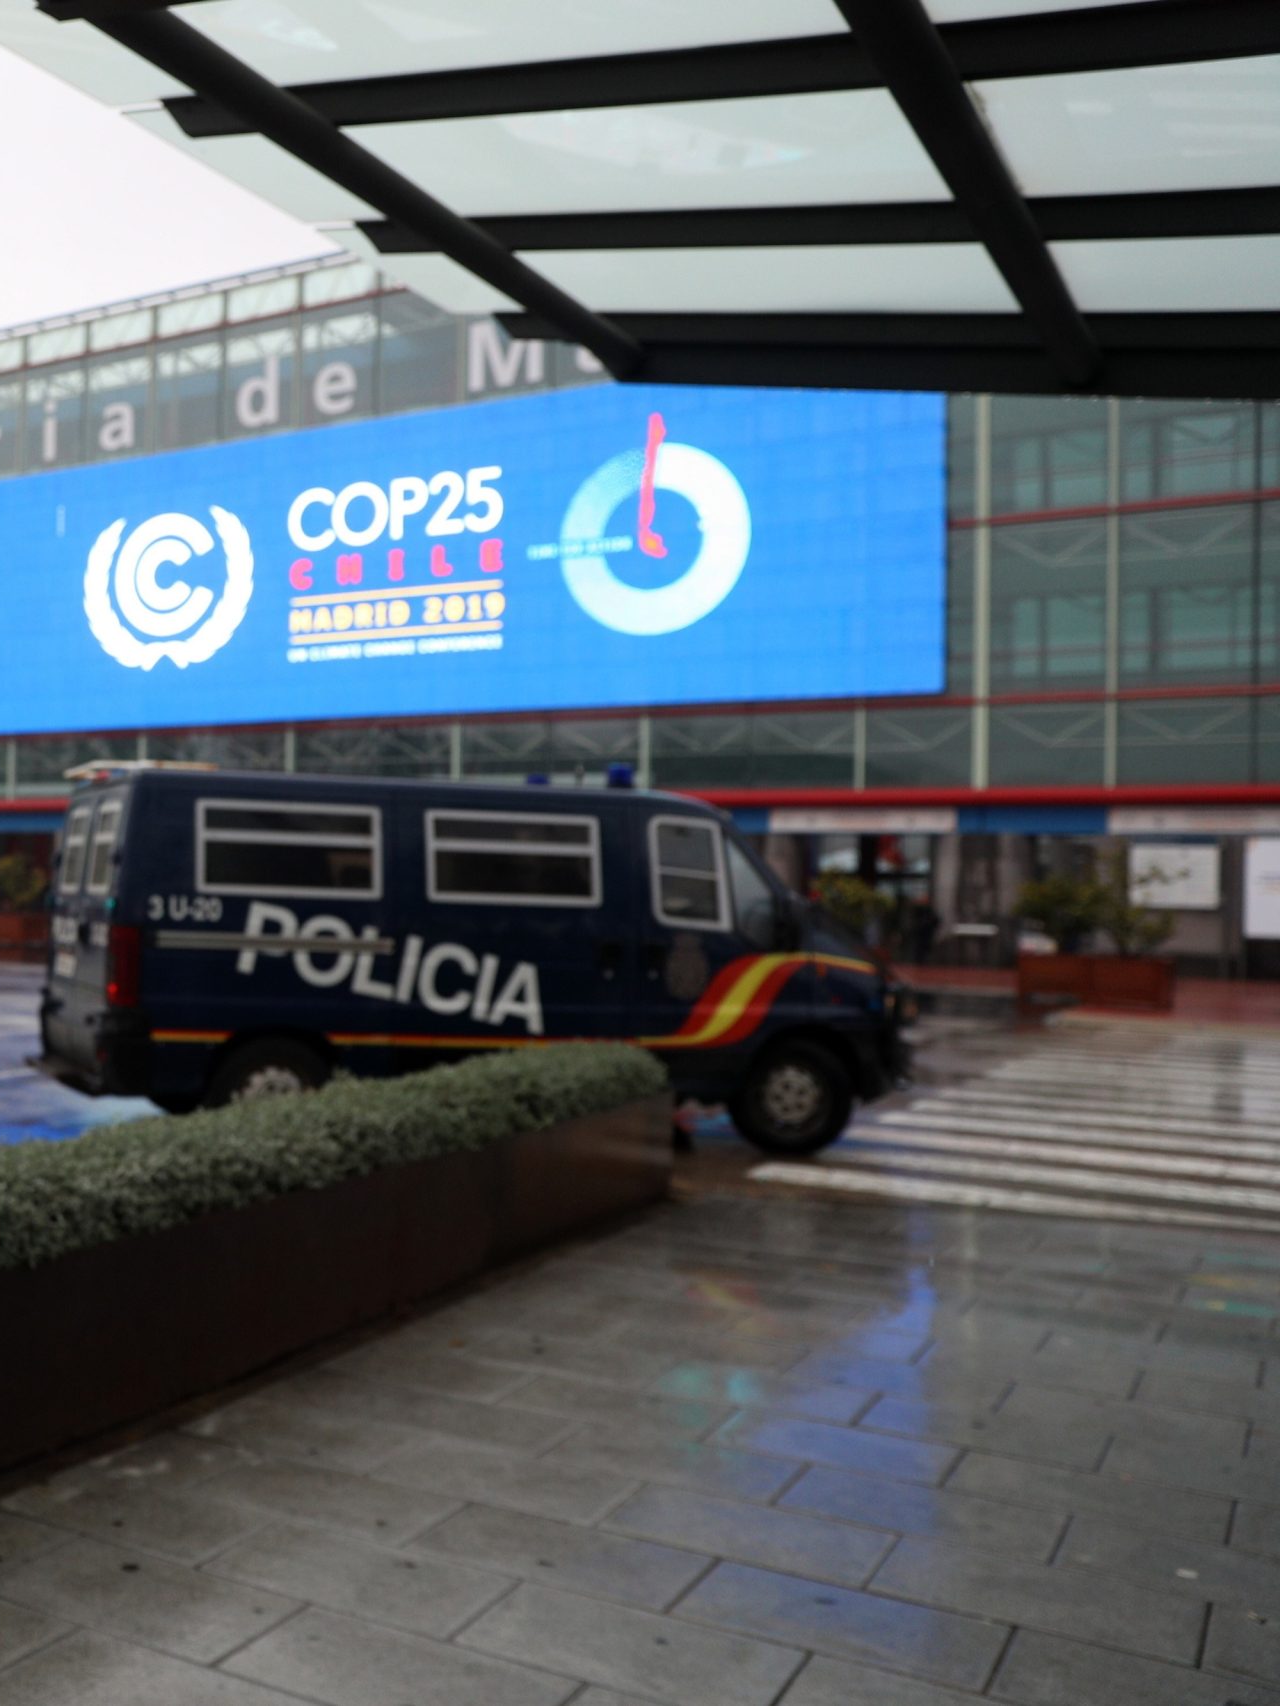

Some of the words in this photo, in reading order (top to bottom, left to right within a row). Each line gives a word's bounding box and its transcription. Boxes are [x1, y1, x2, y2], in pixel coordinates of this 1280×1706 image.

[237, 353, 358, 427] de
[287, 465, 504, 551] COP25
[289, 538, 504, 591] CHILE
[289, 600, 410, 634] MADRID
[423, 591, 505, 623] 2019
[147, 894, 165, 921] 3
[236, 901, 544, 1035] POLICIA
